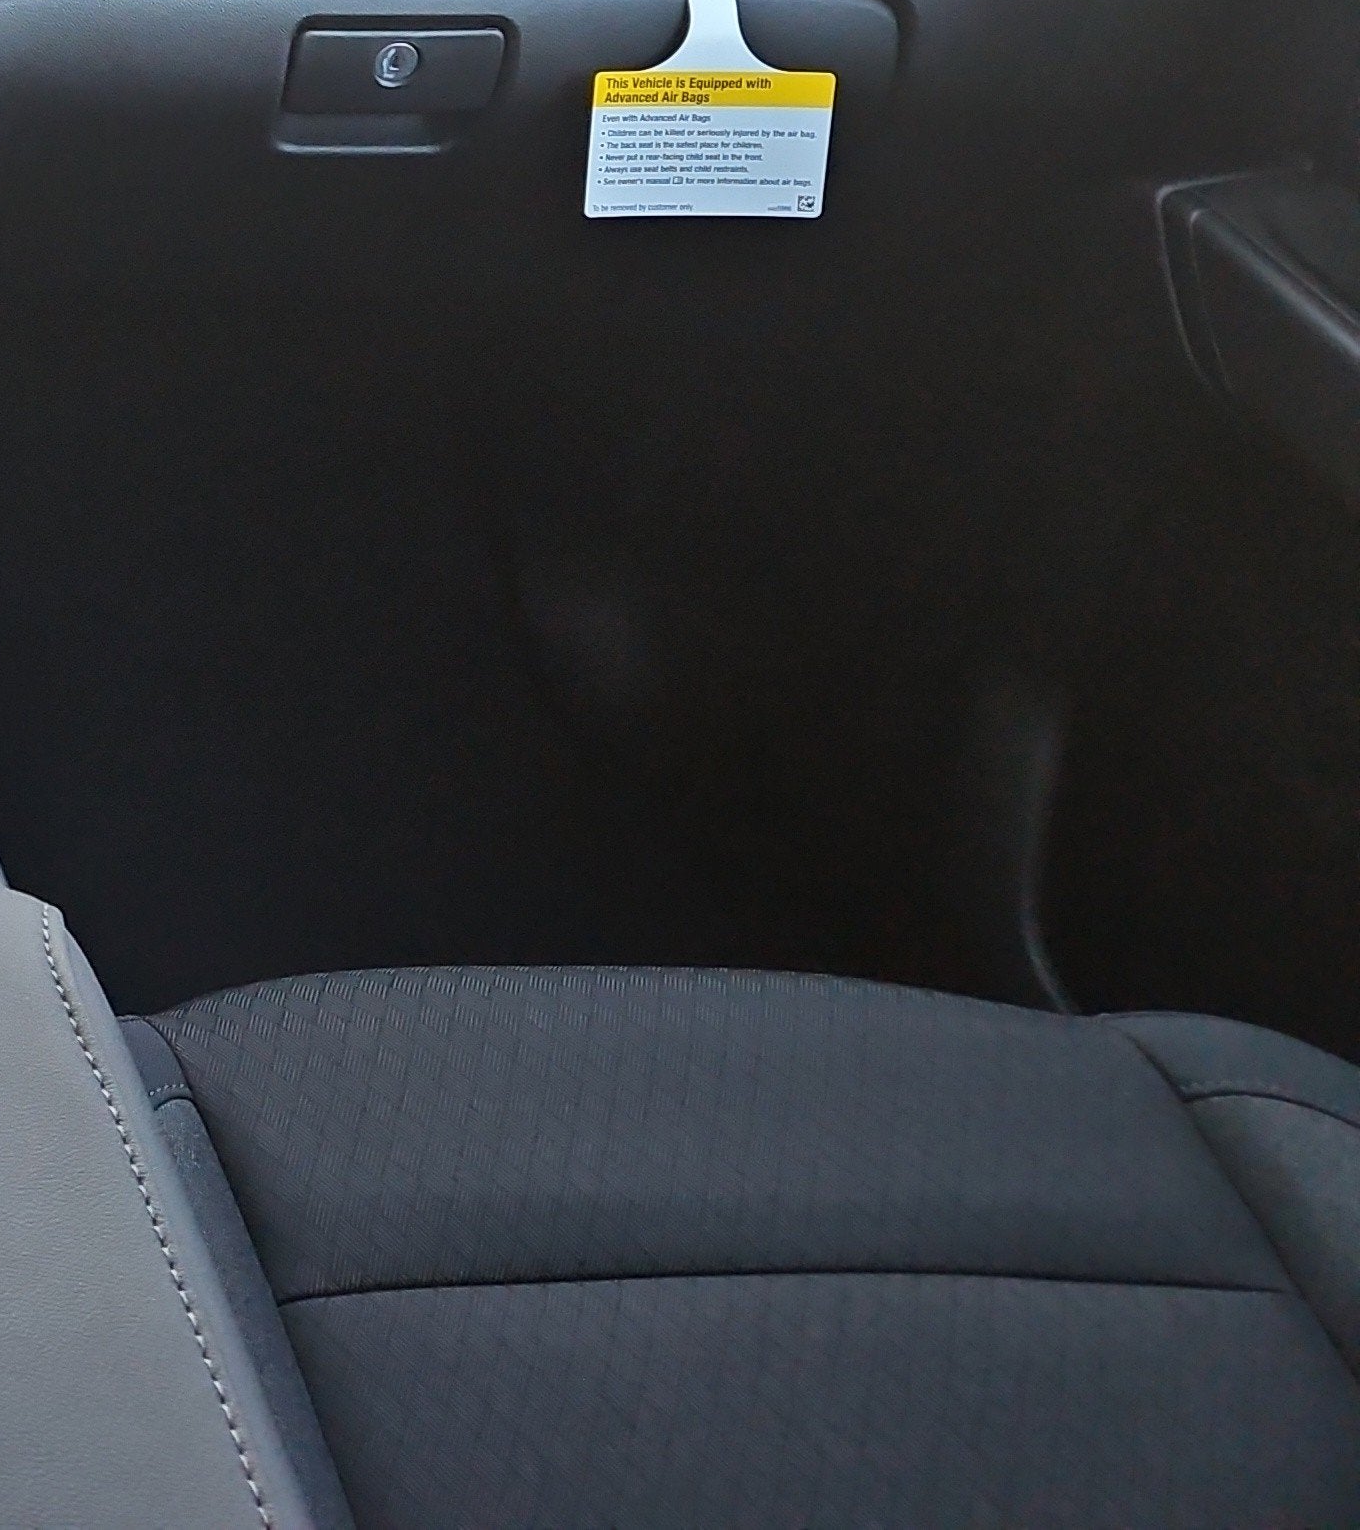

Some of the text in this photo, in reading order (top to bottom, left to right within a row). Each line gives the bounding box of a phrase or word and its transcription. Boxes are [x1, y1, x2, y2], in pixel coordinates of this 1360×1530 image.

[606, 77, 772, 91] This Vehicle is Equipped with
[604, 91, 710, 105] Advanced Air Bags
[602, 114, 712, 123] Even with Advanced Air Bags
[697, 130, 730, 138] seriously
[732, 130, 760, 138] injured
[762, 130, 771, 138] by
[788, 130, 798, 138] air
[800, 130, 817, 139] bag.
[700, 142, 719, 150] place
[626, 154, 638, 162] put
[646, 154, 684, 162] rear-facing
[604, 166, 628, 174] Always
[759, 178, 780, 186] about
[782, 178, 792, 186] air
[592, 204, 600, 212] To
[600, 204, 608, 212] be
[610, 204, 638, 212] removed
[638, 204, 646, 212] by
